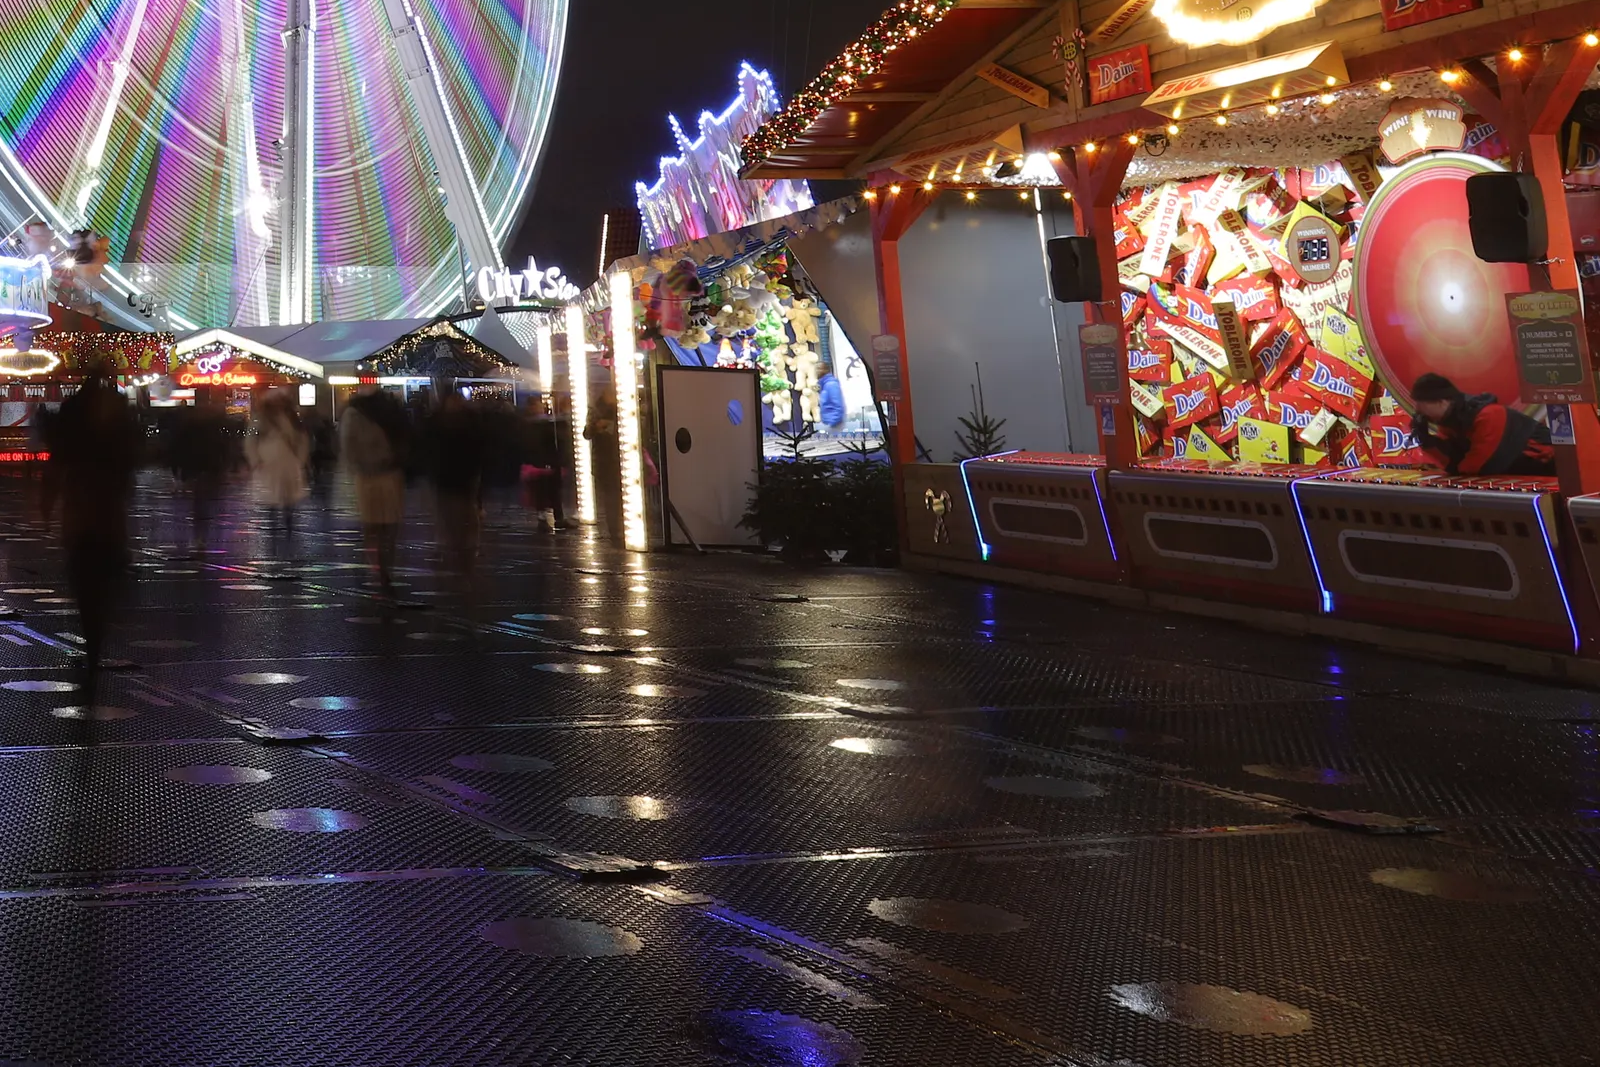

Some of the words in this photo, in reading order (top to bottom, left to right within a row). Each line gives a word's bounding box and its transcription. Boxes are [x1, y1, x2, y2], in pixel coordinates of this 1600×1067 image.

[1097, 60, 1138, 90] Daim
[1383, 115, 1409, 137] WIN!
[1425, 109, 1457, 121] WIN!
[1461, 122, 1497, 151] aim
[1150, 192, 1180, 262] TOBLERONE
[1296, 227, 1327, 237] WINNING
[1301, 262, 1331, 272] NUMBER
[478, 265, 523, 306] City
[1512, 302, 1535, 312] CHOC
[1167, 323, 1222, 359] TOBLERONE
[1217, 310, 1248, 370] TOBLERONE
[1257, 330, 1292, 376] Daim
[1128, 349, 1160, 370] Daim
[25, 388, 45, 398] WIN
[1308, 359, 1355, 399] Daim
[1172, 389, 1207, 418] Daim
[1220, 397, 1253, 433] Daim
[12, 452, 23, 462] ON
